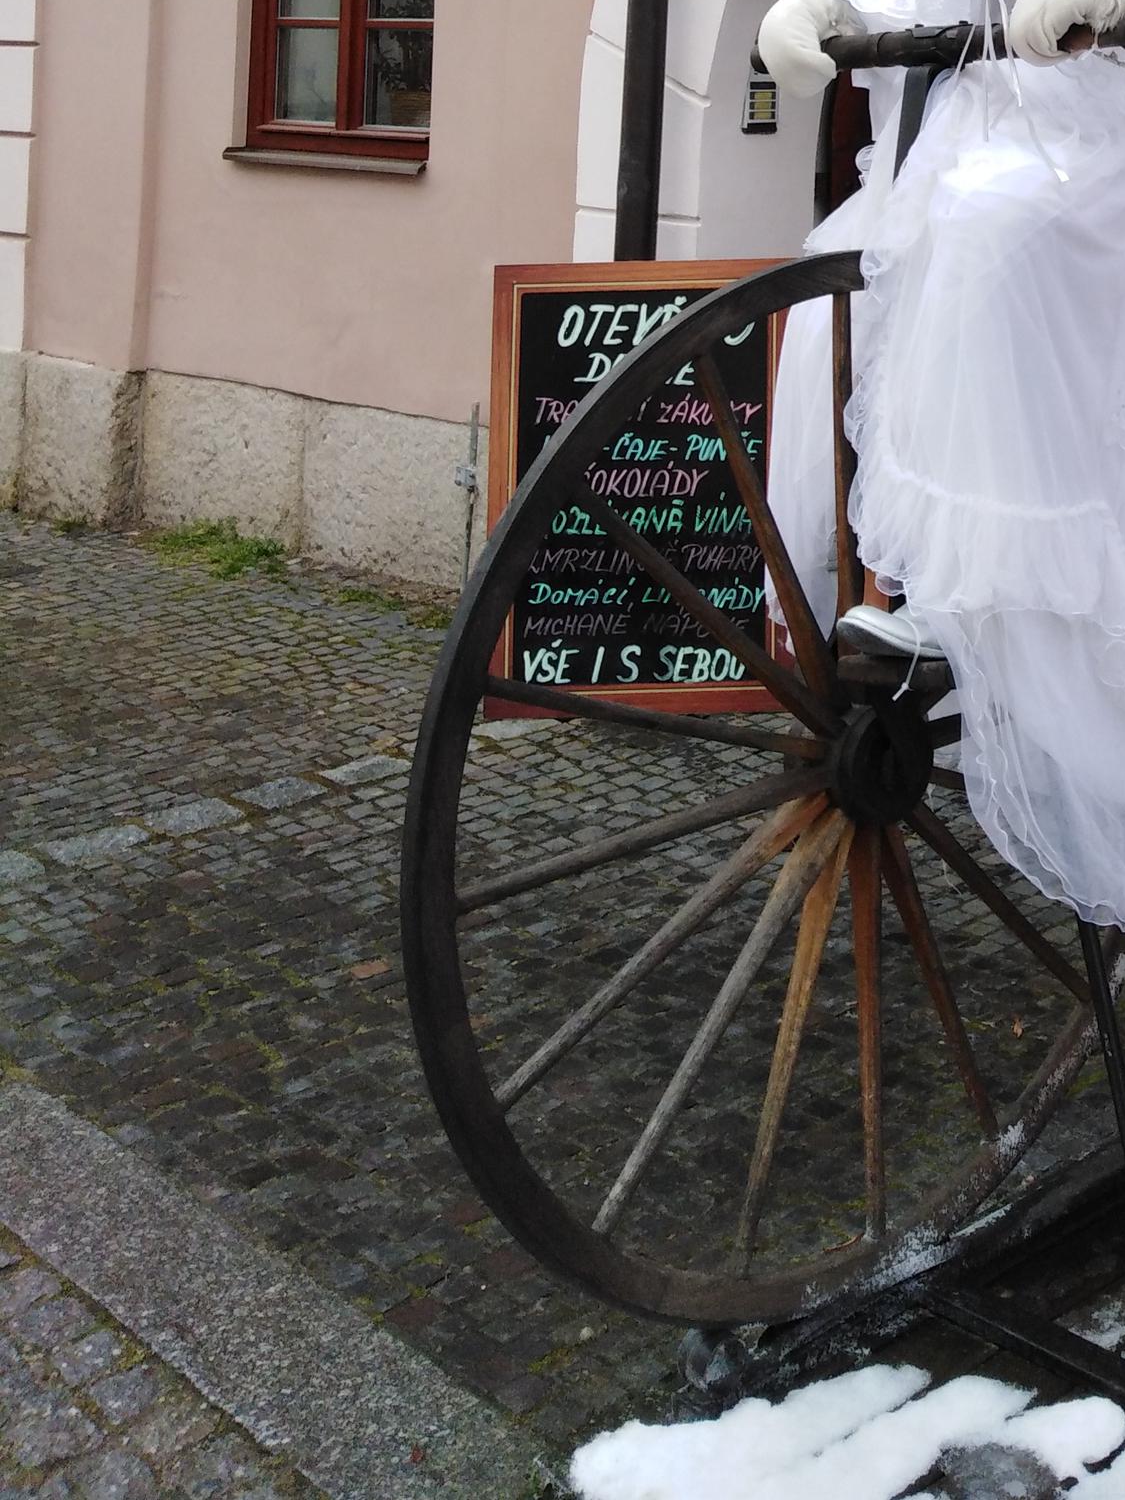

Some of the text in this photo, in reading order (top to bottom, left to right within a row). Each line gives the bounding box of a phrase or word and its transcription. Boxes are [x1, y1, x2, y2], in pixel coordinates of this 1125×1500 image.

[584, 460, 710, 499] OKOLÁDY
[522, 638, 580, 684] VŠE
[616, 644, 642, 683] S
